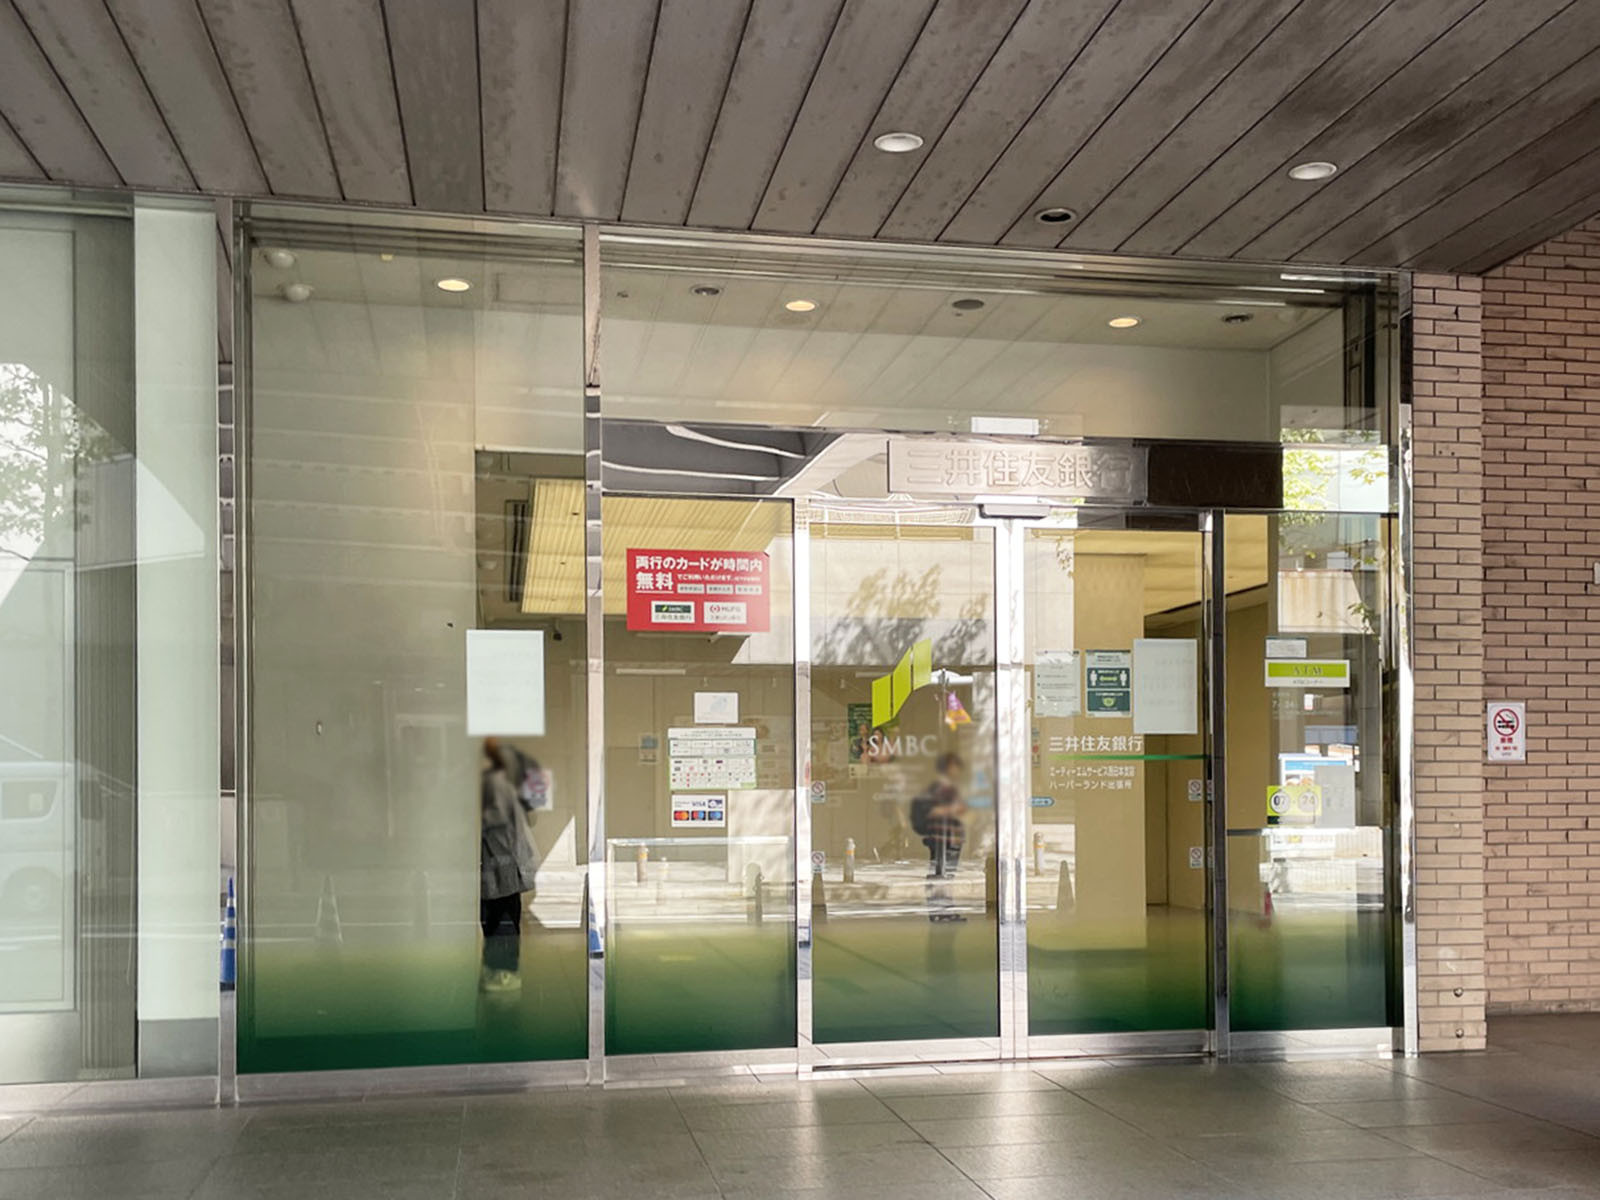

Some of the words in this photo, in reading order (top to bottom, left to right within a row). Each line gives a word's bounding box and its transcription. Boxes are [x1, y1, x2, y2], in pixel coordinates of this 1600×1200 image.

[907, 450, 1133, 492] 三井住友銀行
[635, 555, 763, 573] 両行のカードが時間内
[636, 571, 674, 591] 無料
[868, 735, 937, 757] SMBC
[1048, 735, 1144, 753] 三井住友銀行
